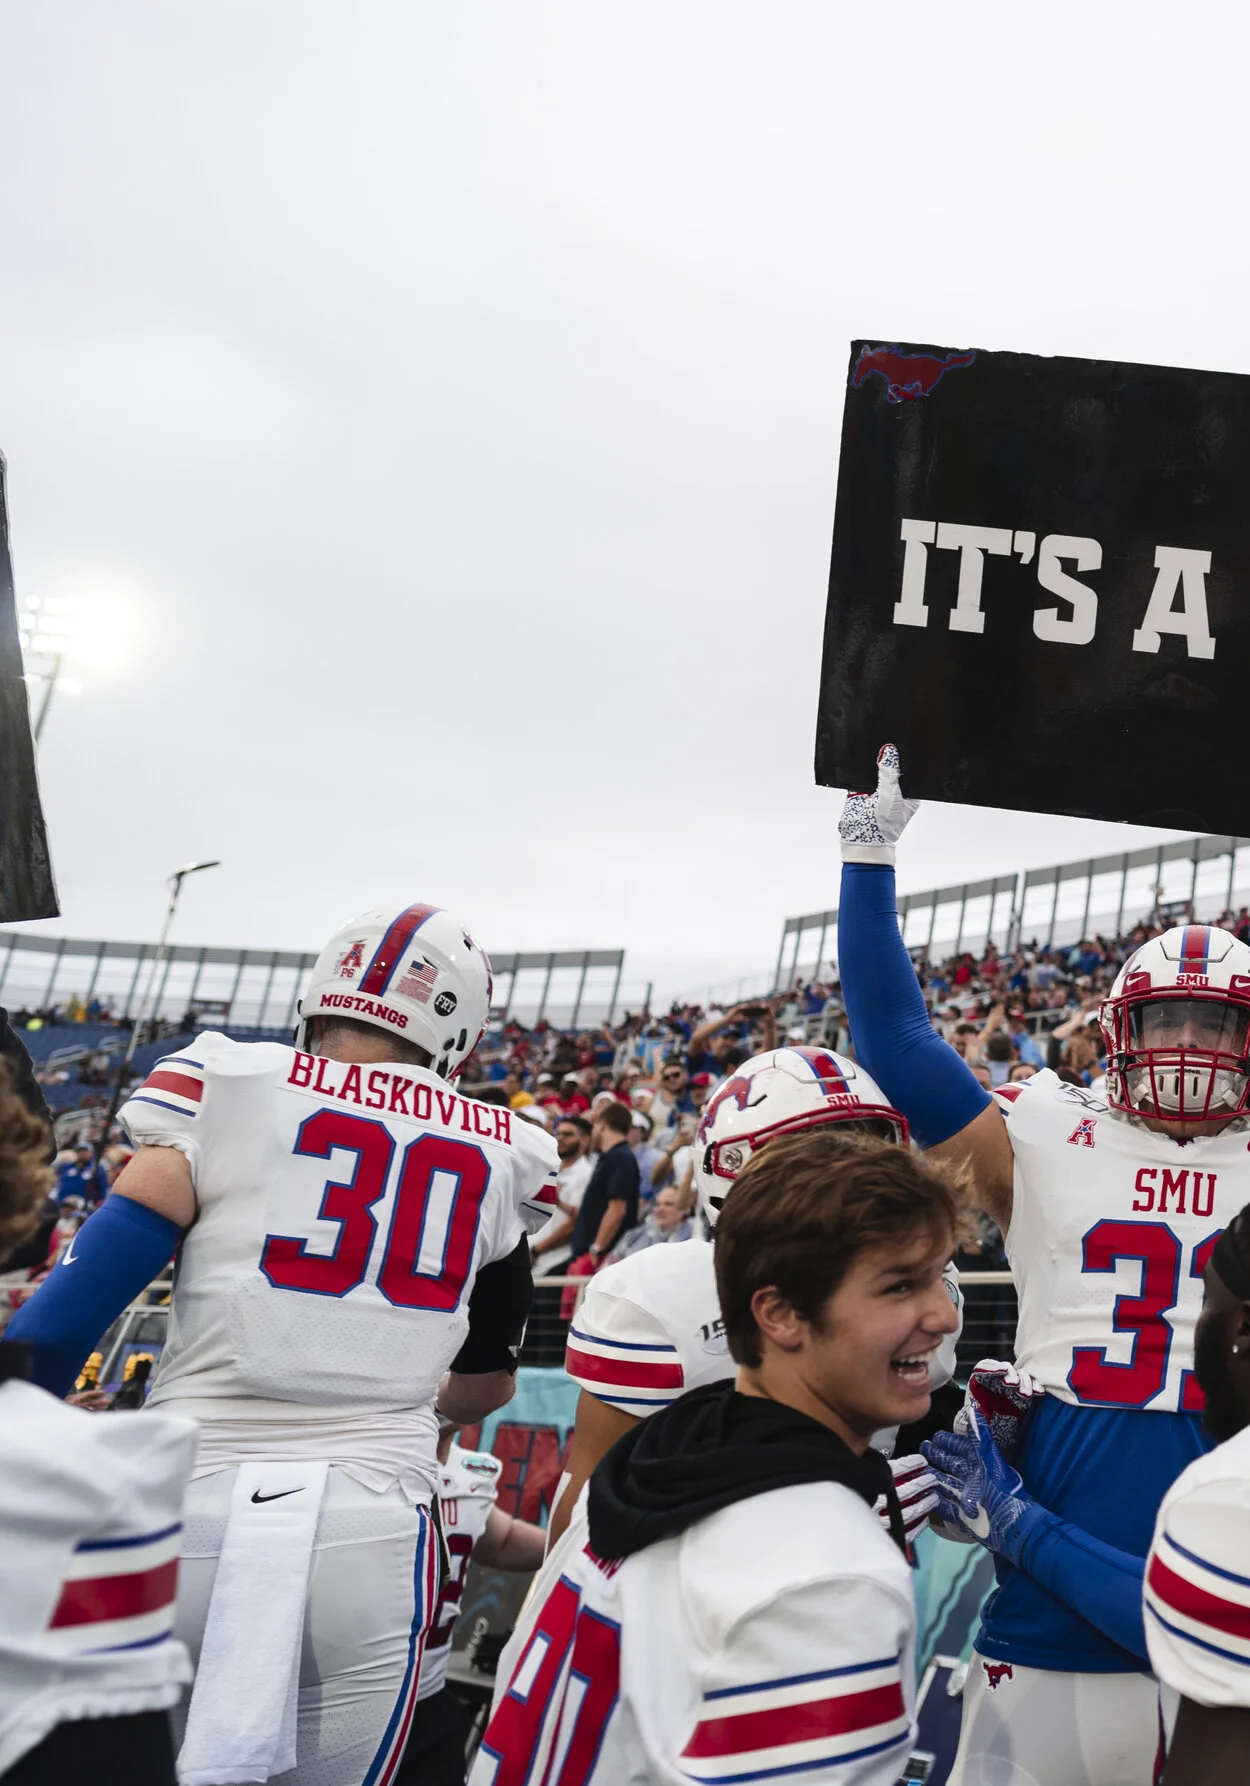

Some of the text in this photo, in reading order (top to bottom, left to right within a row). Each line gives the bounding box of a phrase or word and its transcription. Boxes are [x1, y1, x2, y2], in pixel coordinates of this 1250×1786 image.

[894, 519, 1103, 645] IT'S
[1133, 546, 1216, 660] A
[1176, 975, 1210, 987] SMU
[320, 994, 409, 1029] MUSTANGS
[434, 994, 458, 1014] FRY
[287, 1051, 513, 1146] BLASKOVICH
[827, 1095, 861, 1107] SMU
[259, 1107, 491, 1313] 30
[1132, 1168, 1217, 1217] SMU
[700, 1319, 728, 1342] 15
[1066, 1219, 1225, 1415] 3
